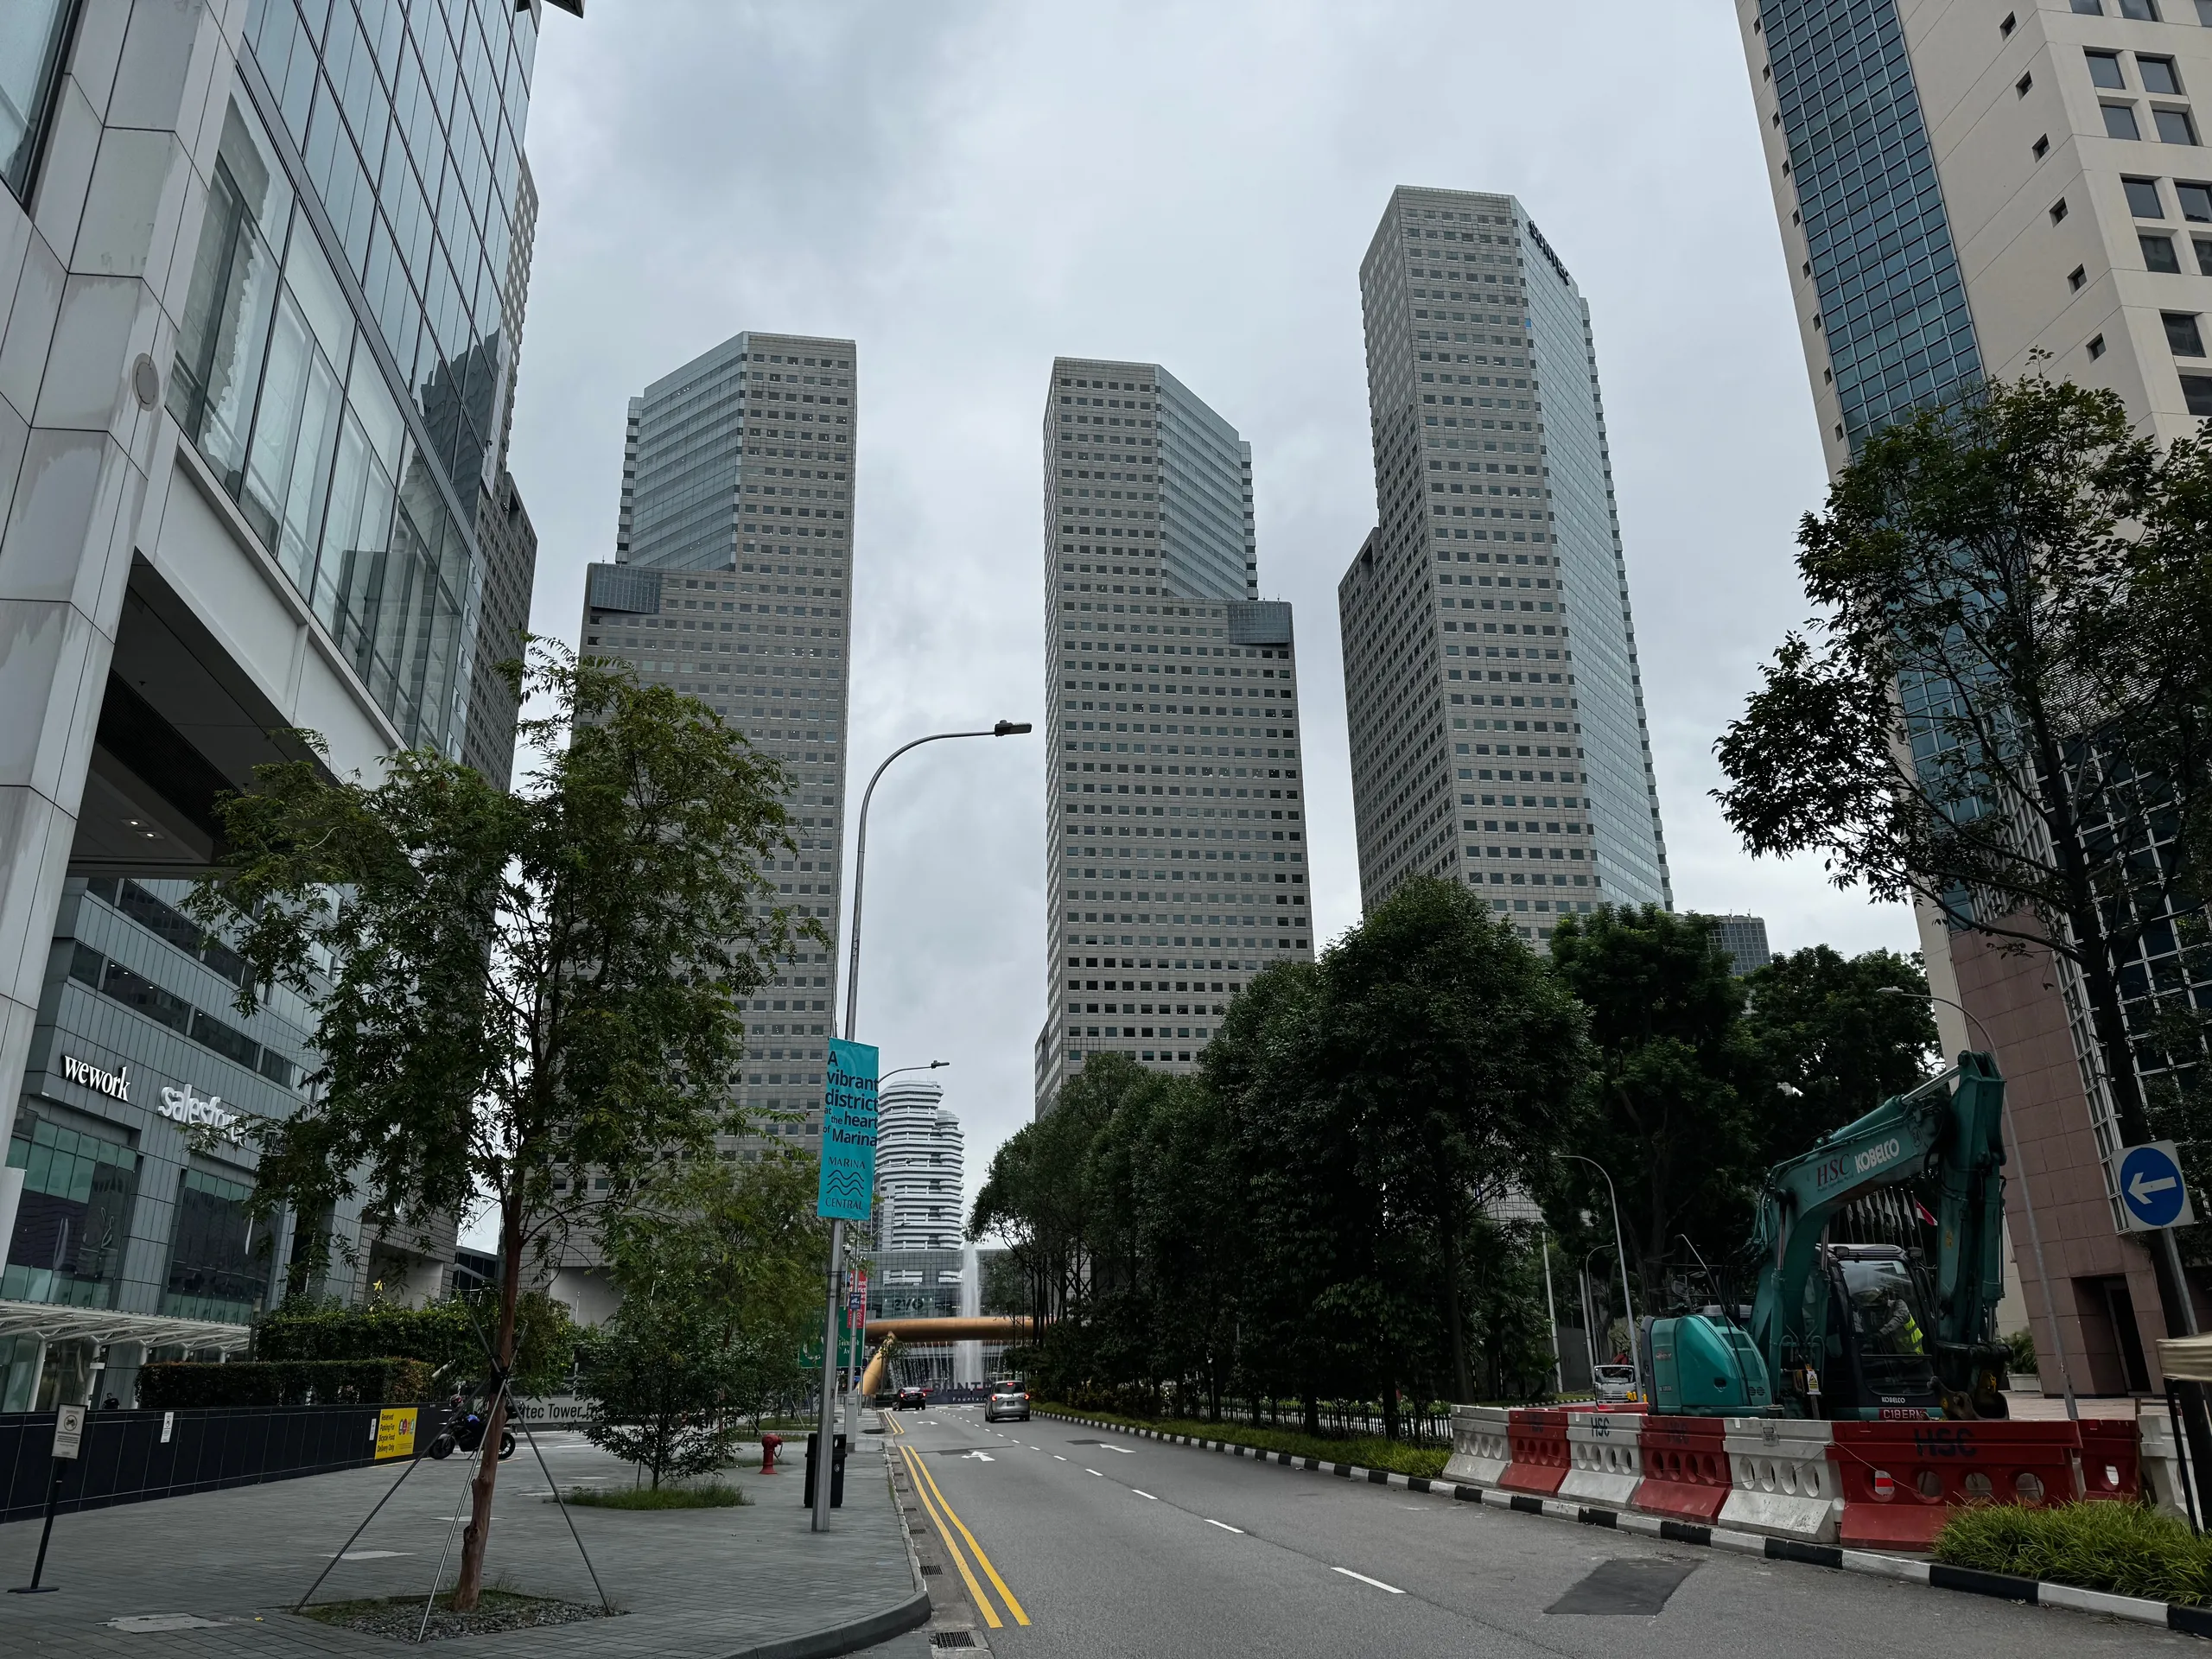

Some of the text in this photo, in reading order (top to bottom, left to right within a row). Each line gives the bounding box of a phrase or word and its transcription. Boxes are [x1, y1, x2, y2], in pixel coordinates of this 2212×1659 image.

[827, 1051, 838, 1066] A
[63, 1055, 130, 1102] wework
[827, 1069, 878, 1091] vibrant
[825, 1089, 878, 1112] district
[831, 1116, 842, 1125] the
[844, 1111, 878, 1128] heart
[823, 1125, 877, 1147] of Marina
[828, 1156, 866, 1169] MARINA
[1817, 1154, 1850, 1186] HSC
[1854, 1138, 1900, 1173] KOBELCO
[825, 1198, 863, 1210] CENTRAL
[521, 1404, 544, 1419] tec
[548, 1403, 582, 1419] Tower
[1591, 1417, 1610, 1438] HSC
[1915, 1427, 1977, 1458] HSC
